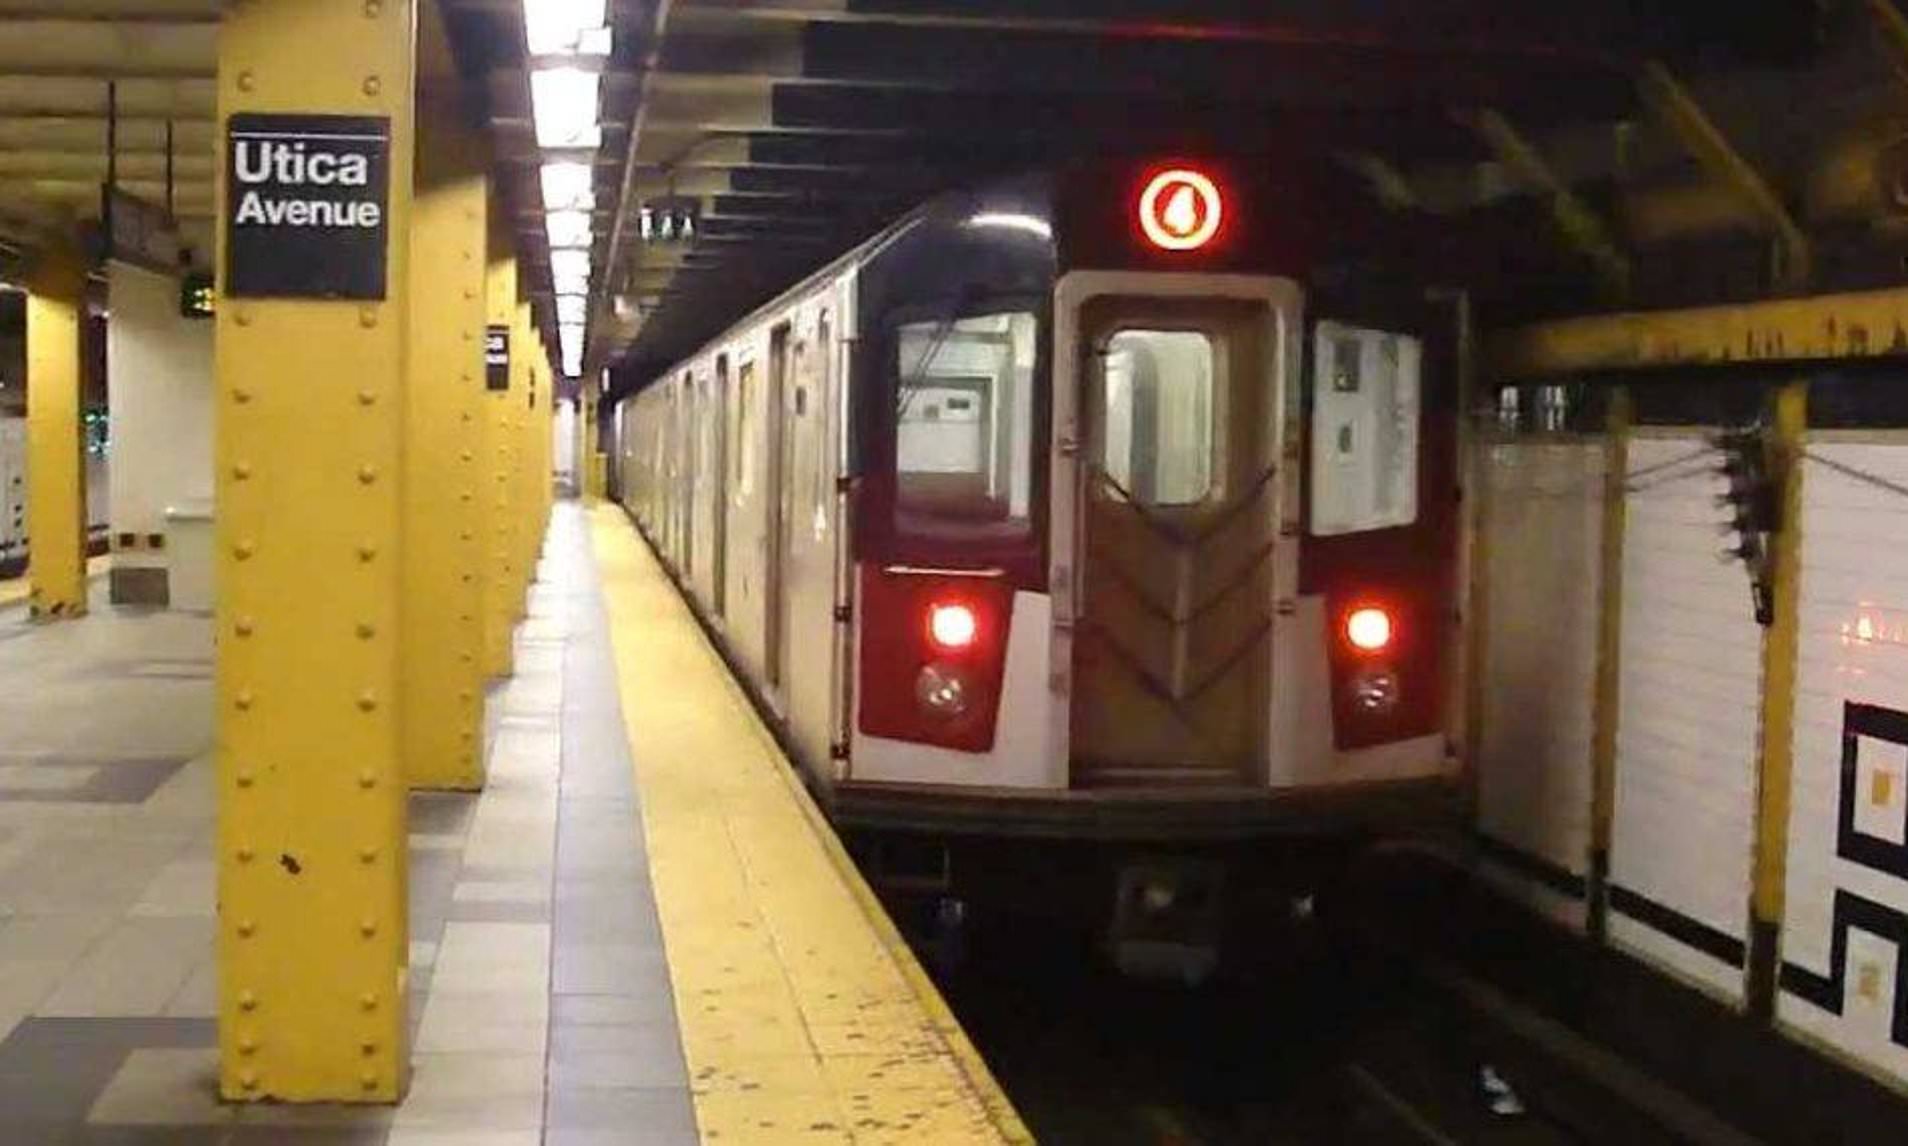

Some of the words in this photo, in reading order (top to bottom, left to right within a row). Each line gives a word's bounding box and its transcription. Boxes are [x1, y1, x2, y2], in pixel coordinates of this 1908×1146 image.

[234, 141, 368, 185] Utica
[235, 190, 381, 228] Avenue
[1163, 185, 1198, 234] 4
